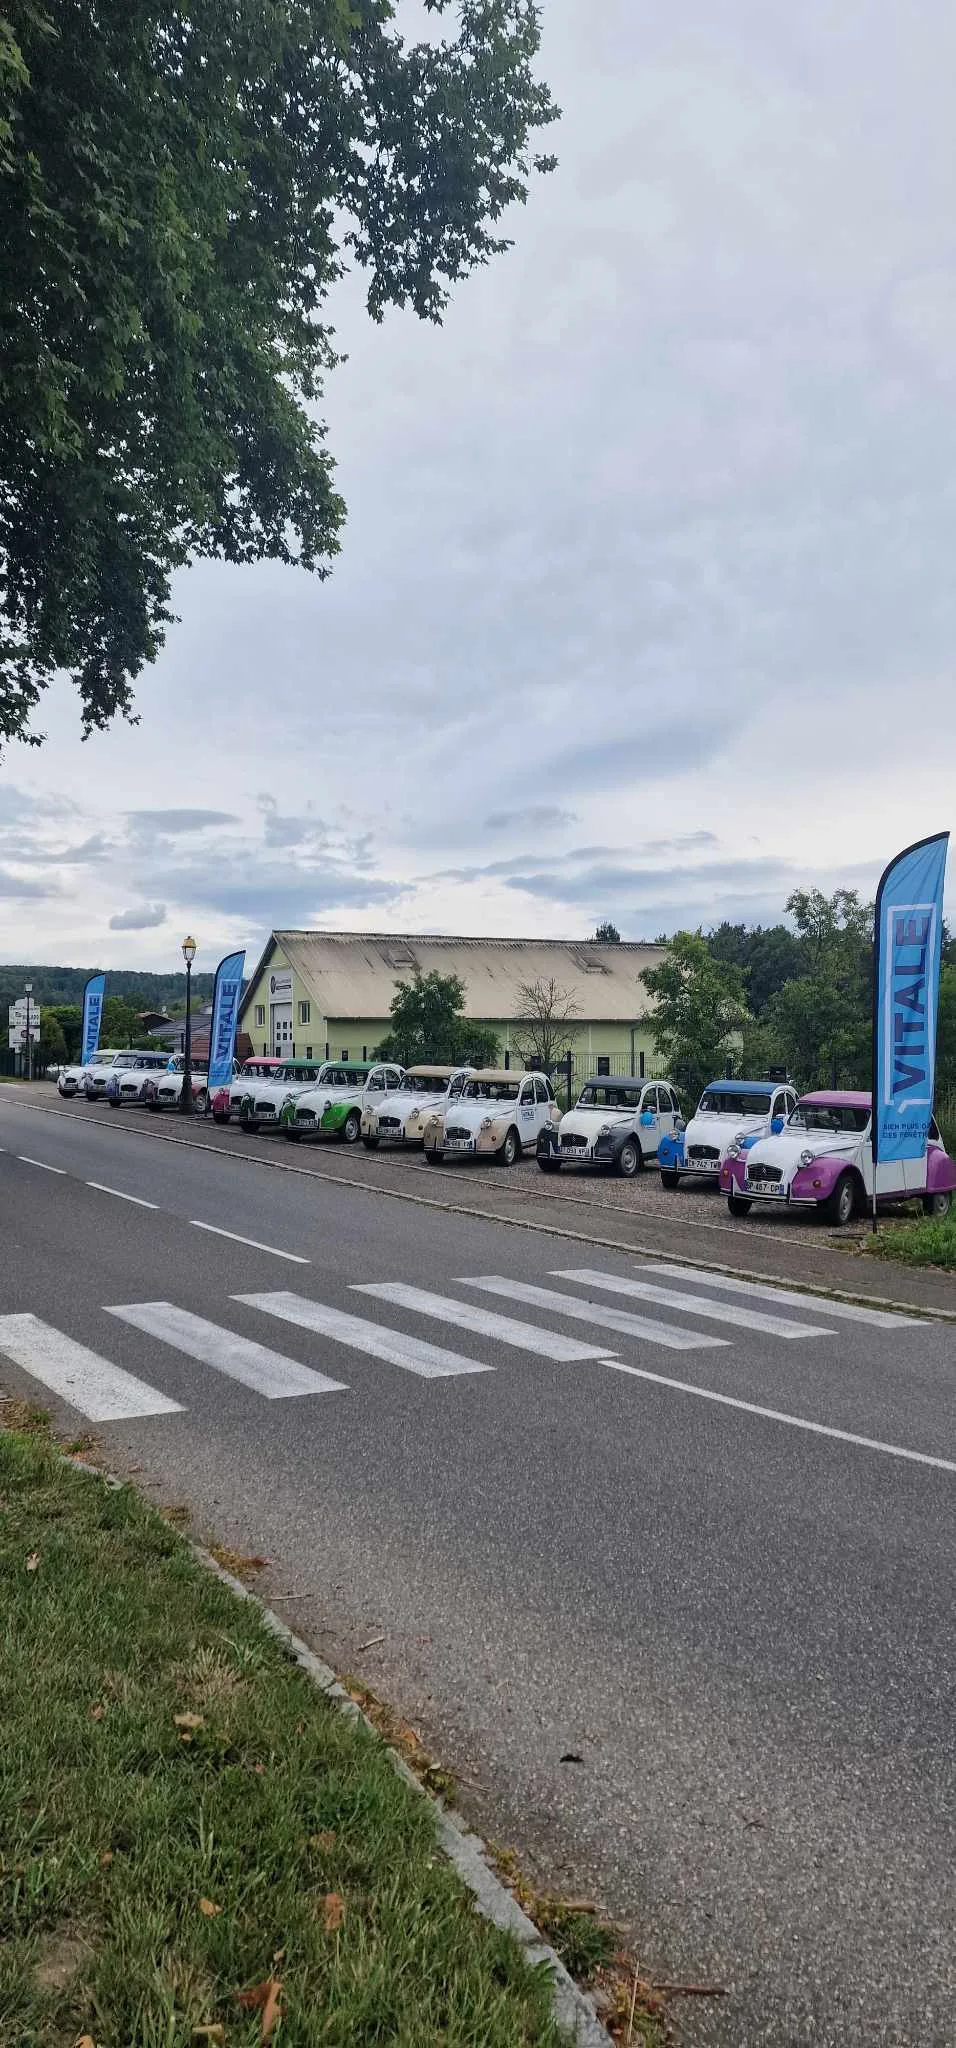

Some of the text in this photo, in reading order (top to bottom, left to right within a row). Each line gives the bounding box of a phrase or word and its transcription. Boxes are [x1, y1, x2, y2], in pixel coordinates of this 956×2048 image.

[86, 997, 100, 1053] VITALE
[215, 981, 238, 1057] VITALE
[892, 916, 929, 1095] VITALE
